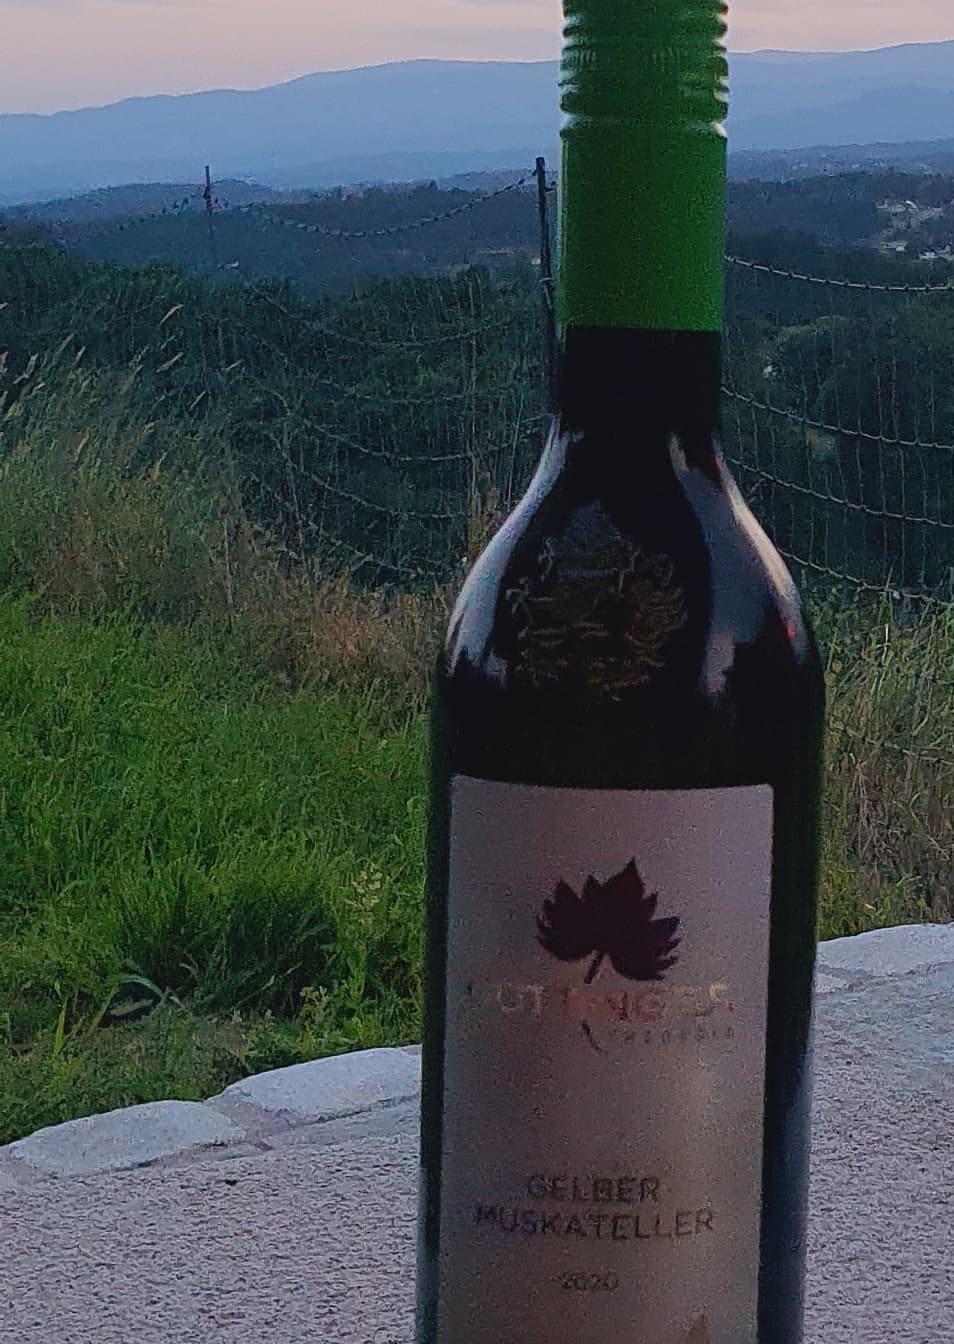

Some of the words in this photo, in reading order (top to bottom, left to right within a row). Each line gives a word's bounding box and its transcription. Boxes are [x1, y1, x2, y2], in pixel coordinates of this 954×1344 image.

[526, 1174, 661, 1203] GELBER
[475, 1204, 715, 1241] MUSKATELLER
[560, 1272, 619, 1292] 2020
